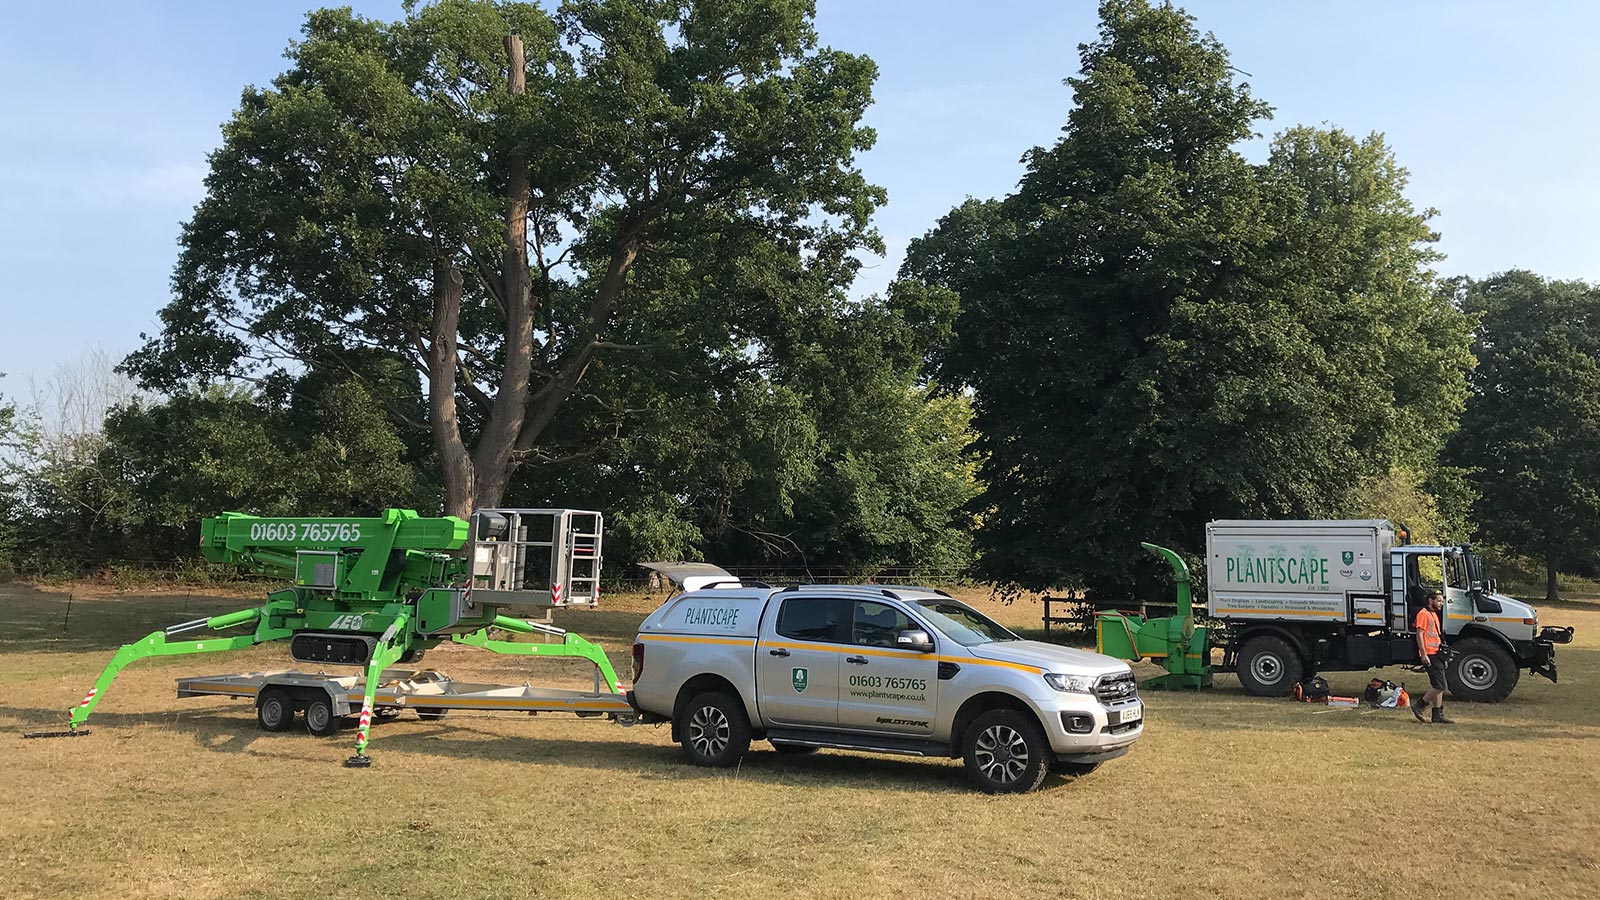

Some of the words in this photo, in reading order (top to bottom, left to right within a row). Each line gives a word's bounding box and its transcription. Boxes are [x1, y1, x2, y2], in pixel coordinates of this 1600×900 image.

[250, 523, 296, 541] 01603
[301, 523, 361, 541] 765765
[1226, 557, 1329, 584] PLANTSCAPE
[328, 614, 363, 630] LEO
[684, 607, 740, 625] PLANTSCAPE
[849, 675, 882, 688] 01603
[884, 677, 926, 690] 765765
[849, 690, 926, 701] www.plantscape.co.uk
